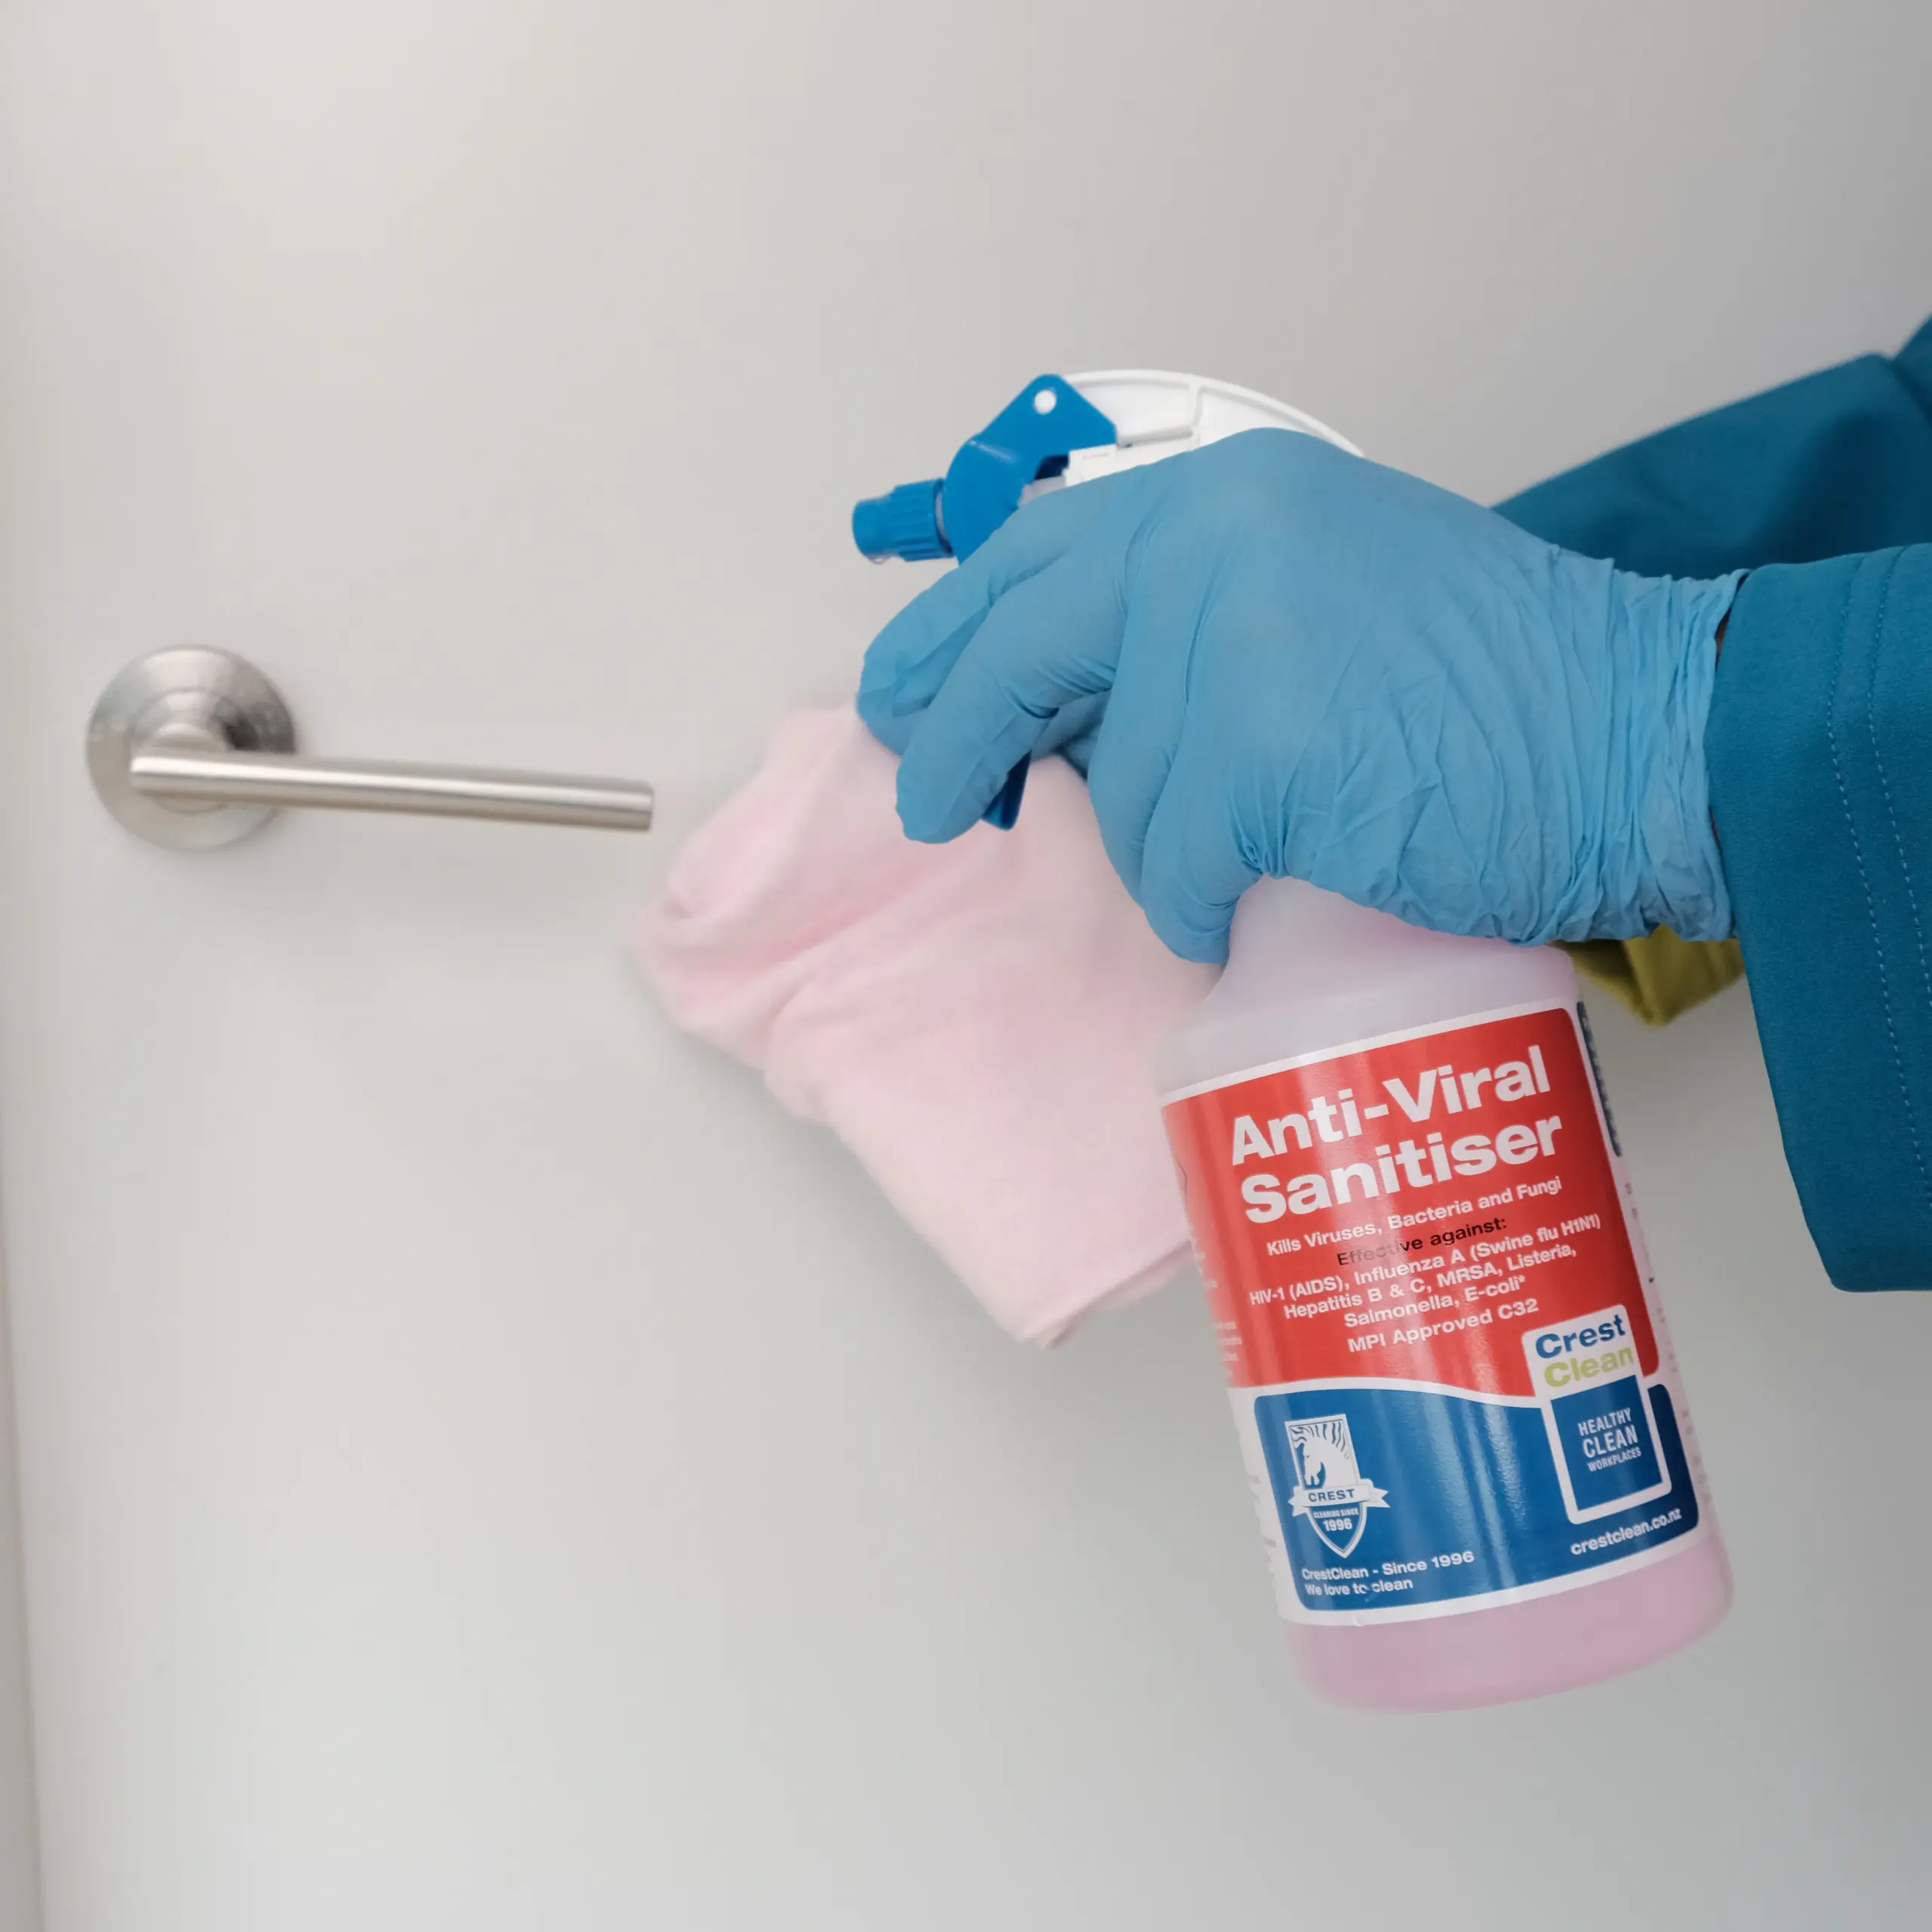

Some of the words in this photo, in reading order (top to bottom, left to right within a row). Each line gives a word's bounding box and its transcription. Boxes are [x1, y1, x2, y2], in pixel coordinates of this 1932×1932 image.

[1232, 1045, 1550, 1165] Anti-Viral
[1241, 1115, 1562, 1223] Sanitiser
[1266, 1238, 1302, 1256] Kills
[1304, 1223, 1383, 1247] Viruses,
[1387, 1201, 1473, 1230] Bacteria
[1478, 1188, 1513, 1209] and
[1516, 1176, 1561, 1200] Fungi
[1249, 1287, 1284, 1305] HIV-1
[1289, 1275, 1349, 1301] (AIDS),
[1354, 1256, 1445, 1285] Influenza
[1451, 1249, 1466, 1264] A
[1470, 1234, 1534, 1262] (Swine
[1537, 1226, 1559, 1243] flu
[1561, 1214, 1601, 1236] H1N1)
[1337, 1238, 1423, 1266] Effective
[1430, 1217, 1507, 1245] against:
[1284, 1294, 1363, 1319] Hepatitis
[1367, 1287, 1383, 1303] B
[1389, 1284, 1404, 1298] &
[1410, 1278, 1432, 1294] C,
[1436, 1262, 1503, 1288] MRSA,
[1506, 1244, 1577, 1271] Listeria,
[1344, 1294, 1460, 1327] Salmonella,
[1347, 1333, 1386, 1352] MPI
[1393, 1308, 1493, 1345] Approved
[1497, 1298, 1539, 1320] C32
[1535, 1314, 1626, 1359] Crest
[1544, 1346, 1635, 1388] Clean
[1577, 1407, 1632, 1437] HEALTHY
[1583, 1424, 1638, 1458] CLEAN
[1587, 1446, 1641, 1472] WORKPLACES
[1309, 1488, 1355, 1502] CREST
[1322, 1518, 1352, 1531] 1996
[1570, 1508, 1682, 1555] crestclean.co.nz
[1301, 1567, 1369, 1580] CrestClean
[1382, 1560, 1428, 1576] Since
[1431, 1551, 1475, 1569] 1996
[1304, 1583, 1322, 1596] We
[1323, 1583, 1351, 1596] love
[1371, 1579, 1414, 1593] clean
